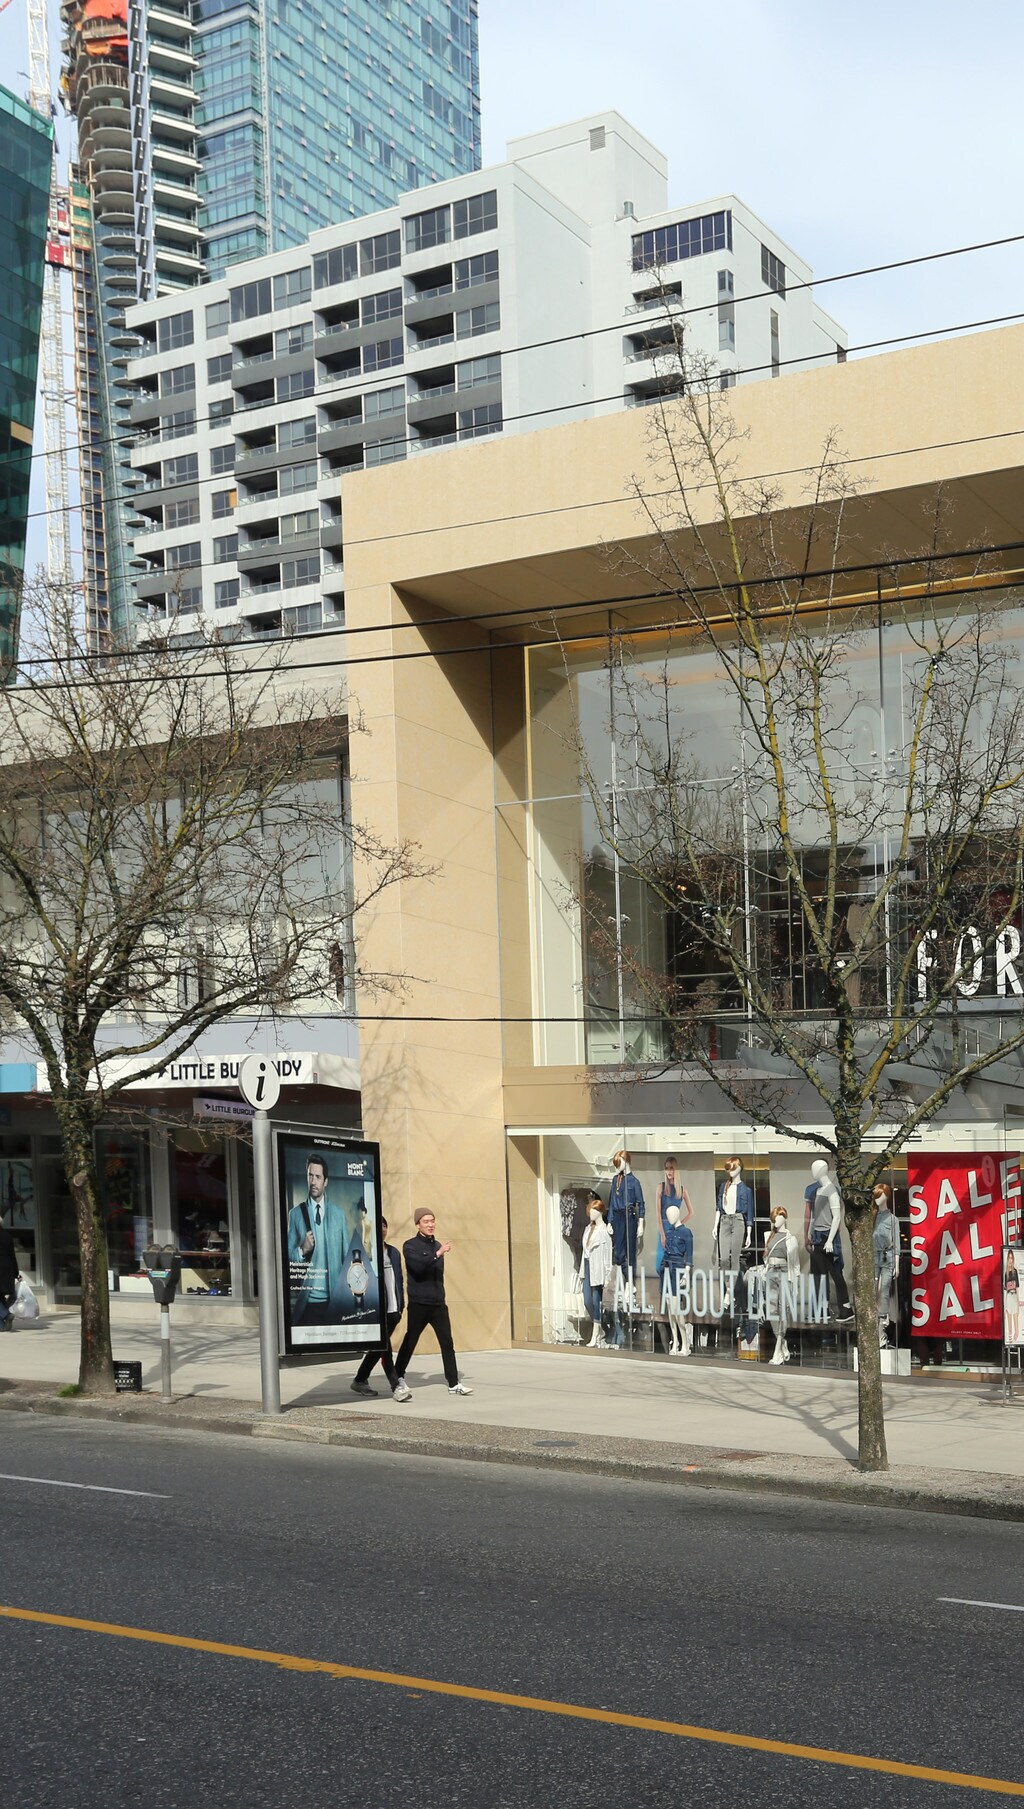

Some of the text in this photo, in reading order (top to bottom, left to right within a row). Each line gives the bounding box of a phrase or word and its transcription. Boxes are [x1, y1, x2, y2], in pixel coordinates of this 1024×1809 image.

[170, 1062, 215, 1081] LITTLE
[220, 1059, 302, 1079] BUNDY
[211, 1104, 231, 1114] LITTLE
[347, 1162, 364, 1170] MONT
[347, 1169, 365, 1177] BLANC
[908, 1156, 1023, 1225] SALE
[910, 1208, 1023, 1276] SALE
[613, 1265, 829, 1325] ALL ABOUT DENIM
[911, 1275, 995, 1328] SAL
